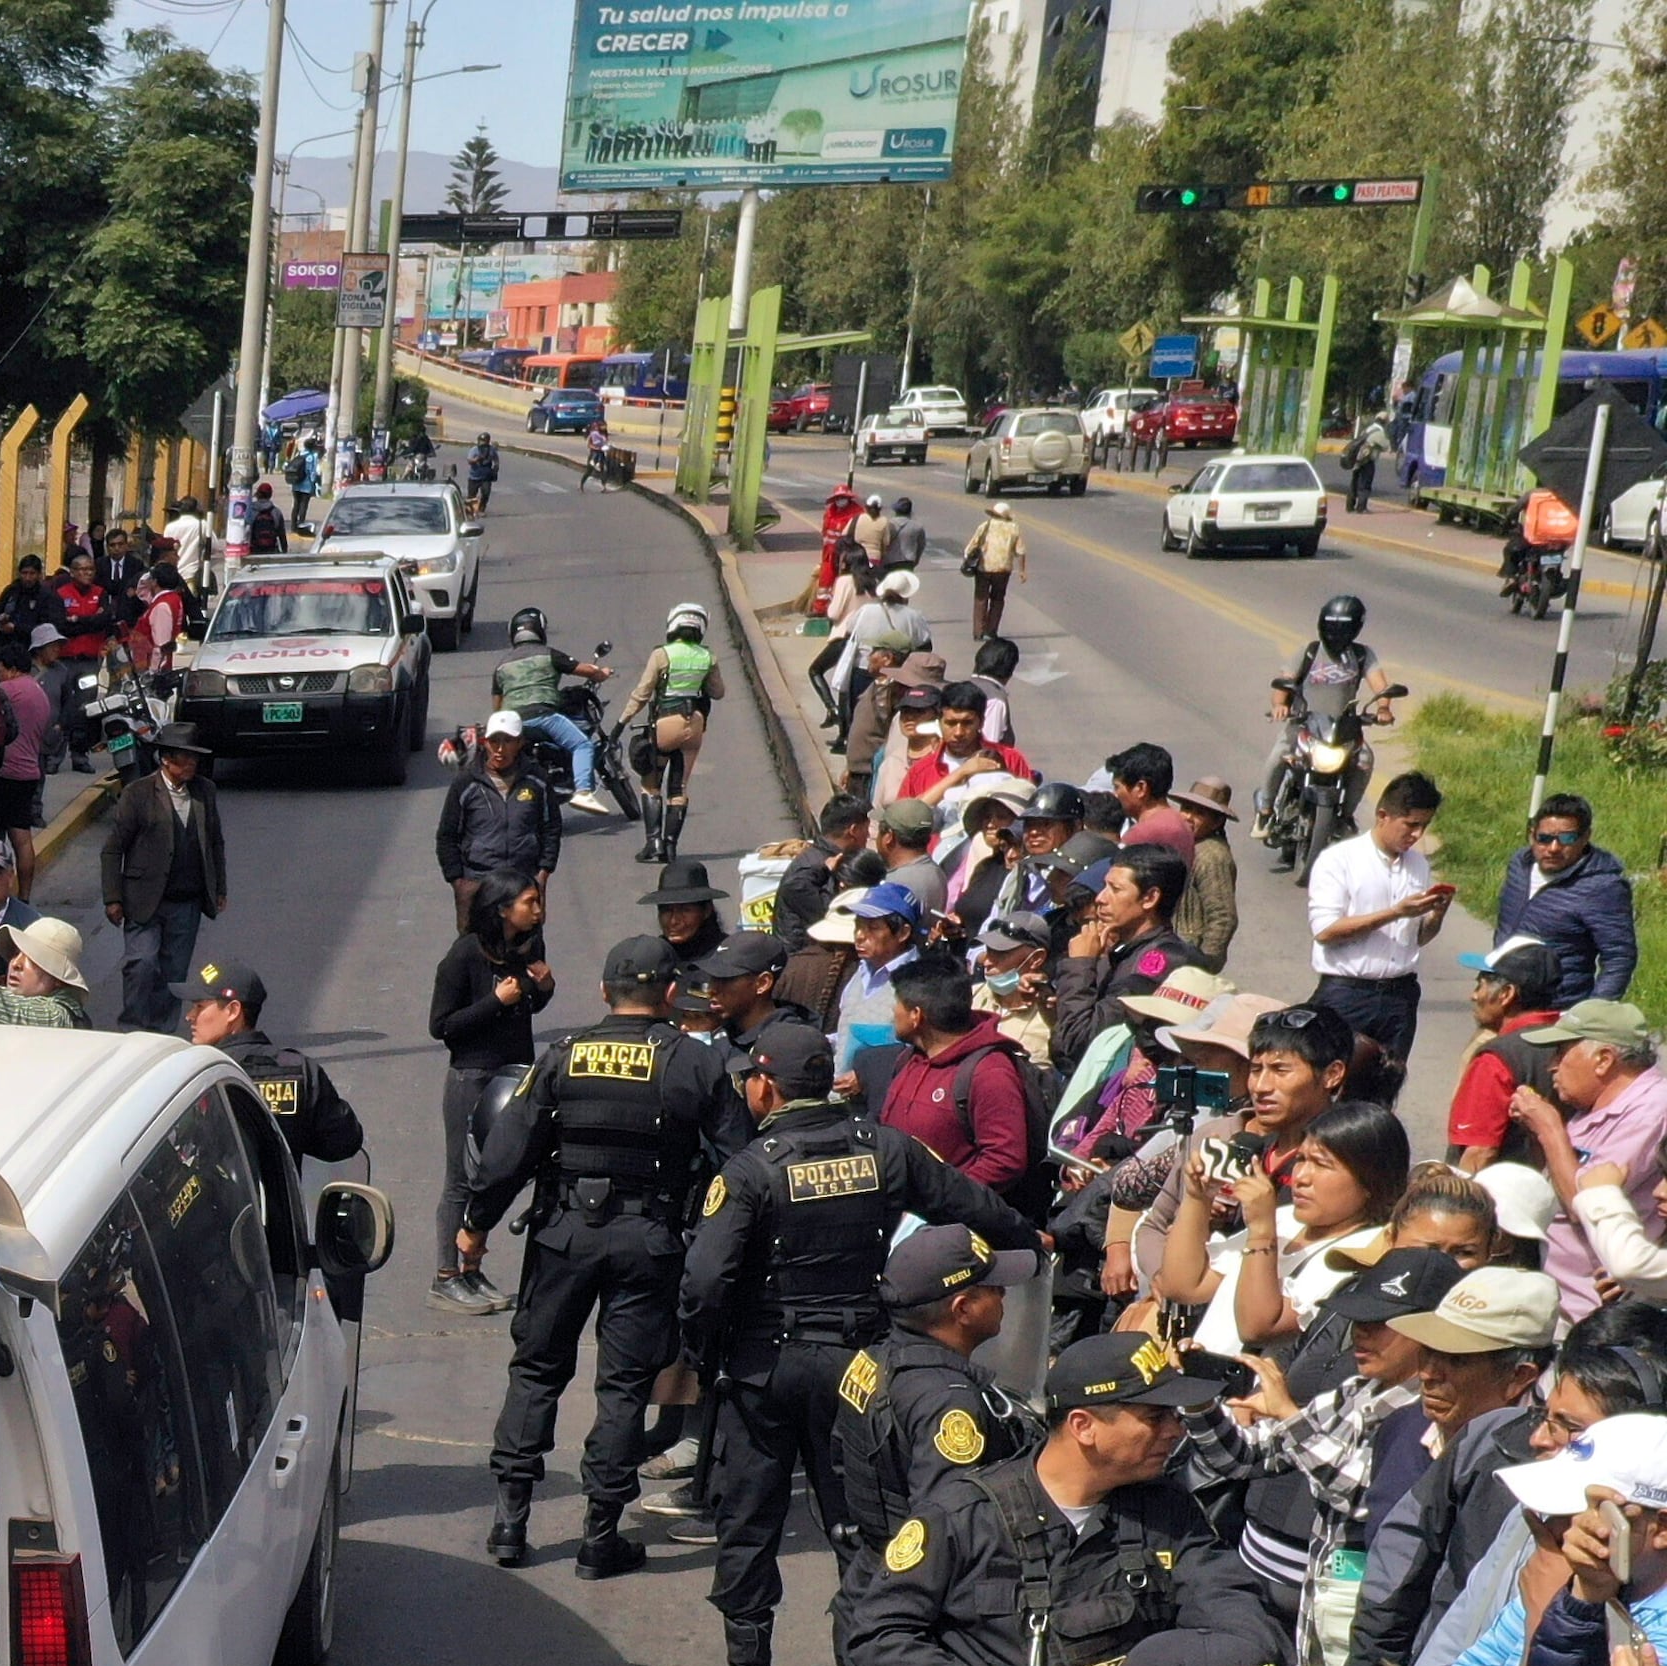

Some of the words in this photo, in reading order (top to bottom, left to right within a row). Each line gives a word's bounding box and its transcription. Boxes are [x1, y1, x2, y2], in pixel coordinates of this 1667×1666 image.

[599, 8, 624, 24] Tu
[628, 4, 688, 22] salud
[695, 6, 734, 20] nos
[738, 0, 828, 22] impulsa
[834, 4, 848, 17] a
[597, 33, 688, 52] CRECER
[590, 68, 644, 78] NUESTRAS
[646, 67, 688, 77] NUEVAS
[690, 64, 773, 75] INSTALACIONES
[850, 63, 957, 99] UROSUR
[287, 264, 337, 276] SOKSO
[341, 294, 366, 302] ZONA
[341, 302, 382, 310] VIGILADA
[574, 1044, 648, 1067] POLICIA
[792, 1159, 873, 1187] POLICIA
[942, 1268, 972, 1288] PERU
[1084, 1381, 1116, 1395] PERU
